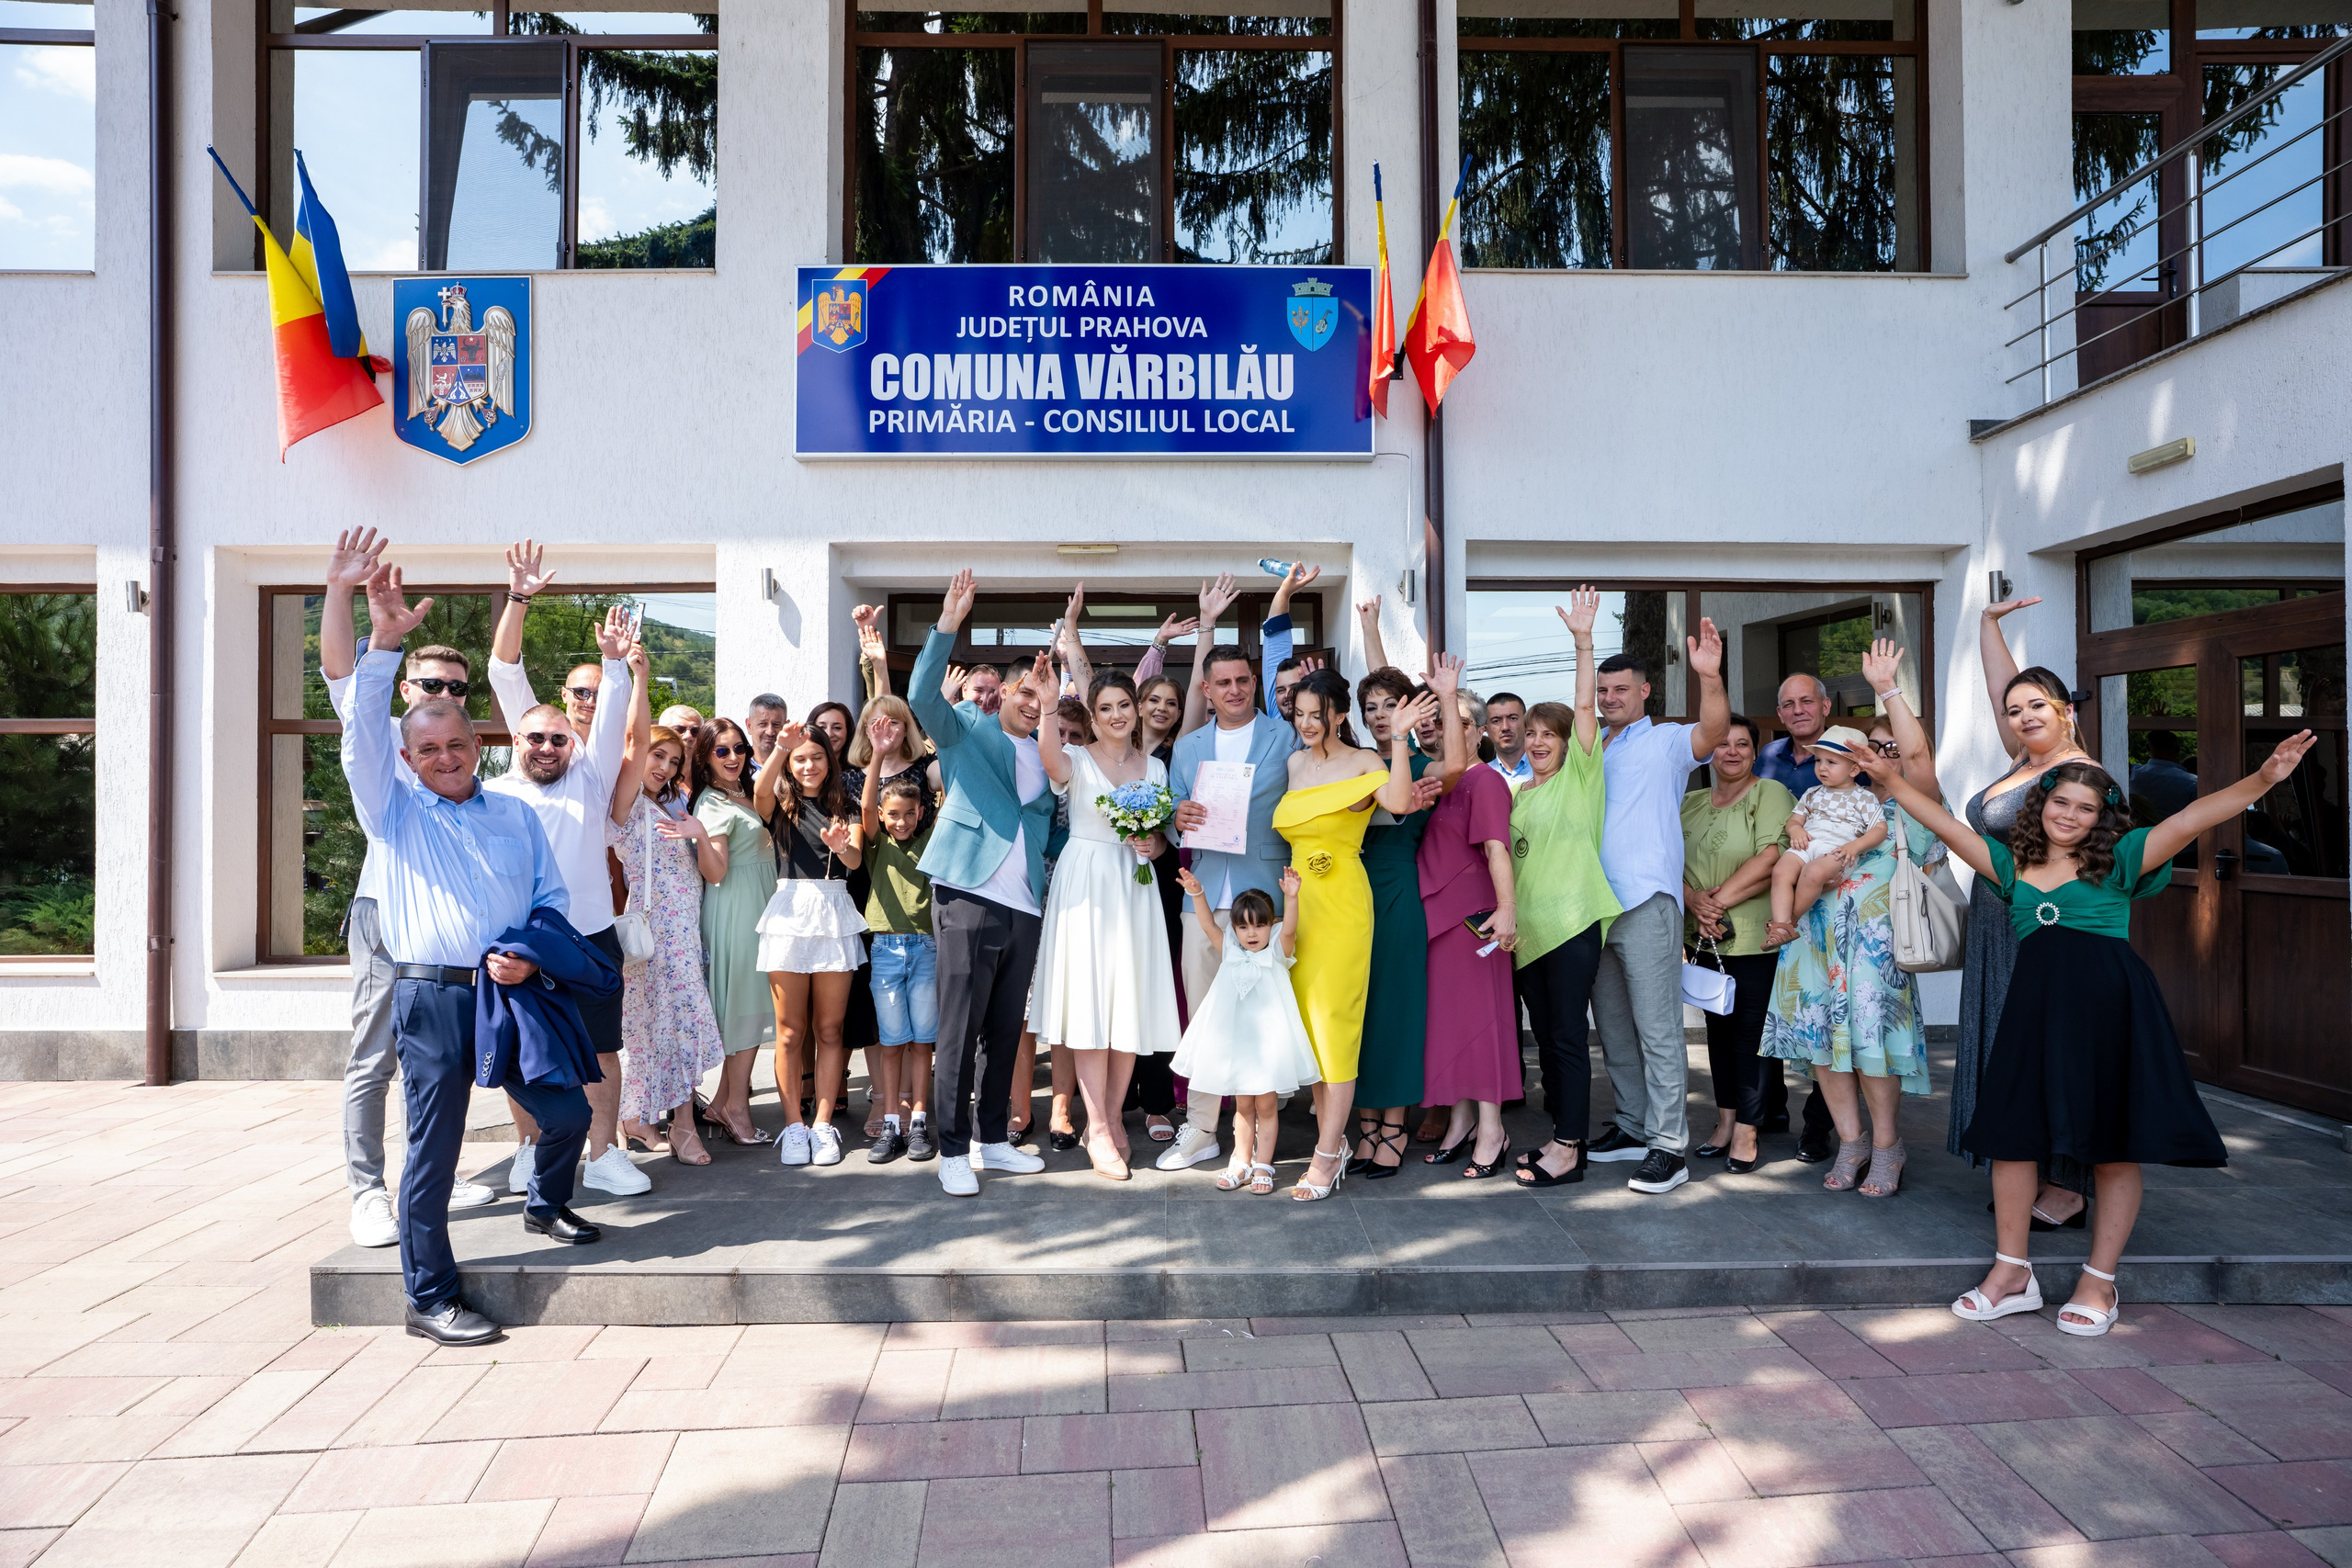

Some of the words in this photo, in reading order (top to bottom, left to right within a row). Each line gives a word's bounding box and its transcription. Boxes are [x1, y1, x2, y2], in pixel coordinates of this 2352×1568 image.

[1009, 280, 1156, 307] ROMÂNIA
[1080, 316, 1208, 338] PRAHOVA
[870, 353, 1066, 401] COMUNA
[1074, 344, 1295, 401] VĂRBILĂU
[869, 403, 1017, 434] PRIMĂRIA
[1044, 409, 1195, 433] CONSILIUL
[1204, 409, 1295, 433] LOCAL
